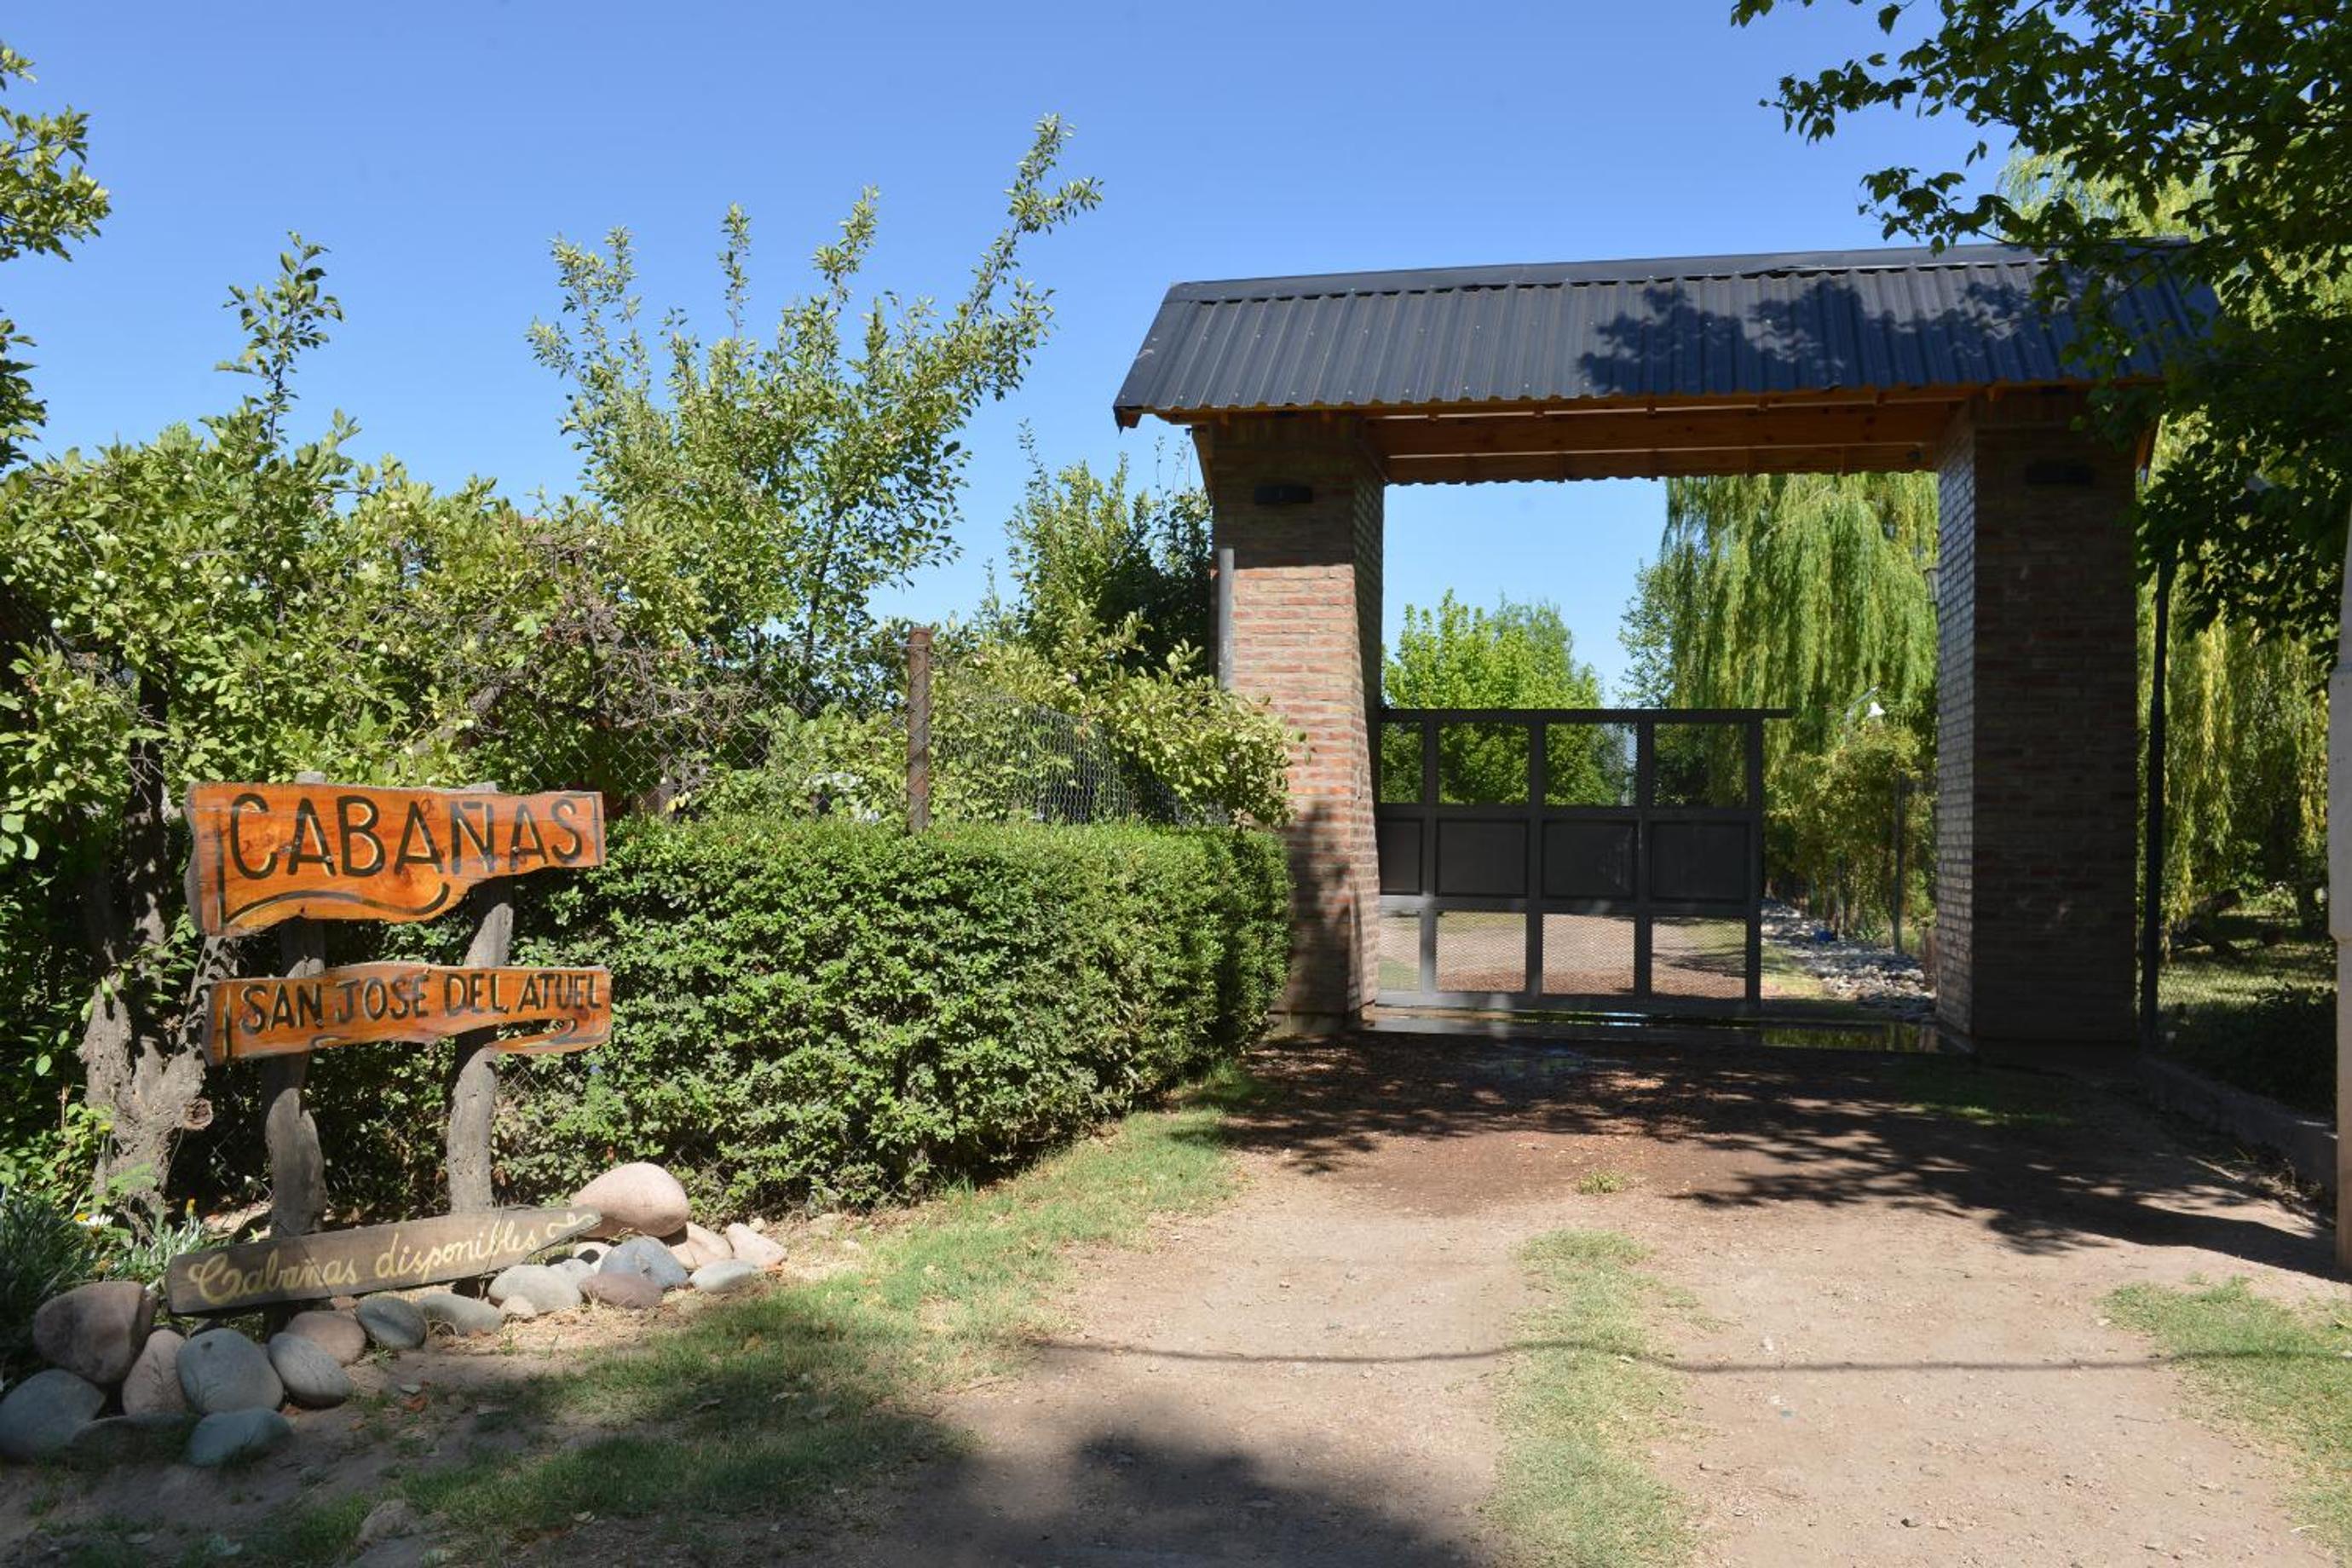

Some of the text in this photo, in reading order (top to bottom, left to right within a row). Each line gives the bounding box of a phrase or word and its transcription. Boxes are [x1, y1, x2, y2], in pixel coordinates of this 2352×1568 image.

[230, 793, 583, 879] CABAÑAS
[239, 983, 324, 1035] SAN
[442, 973, 509, 1017] DEL
[516, 971, 602, 1012] ATUEL
[372, 1220, 539, 1280] disponibles
